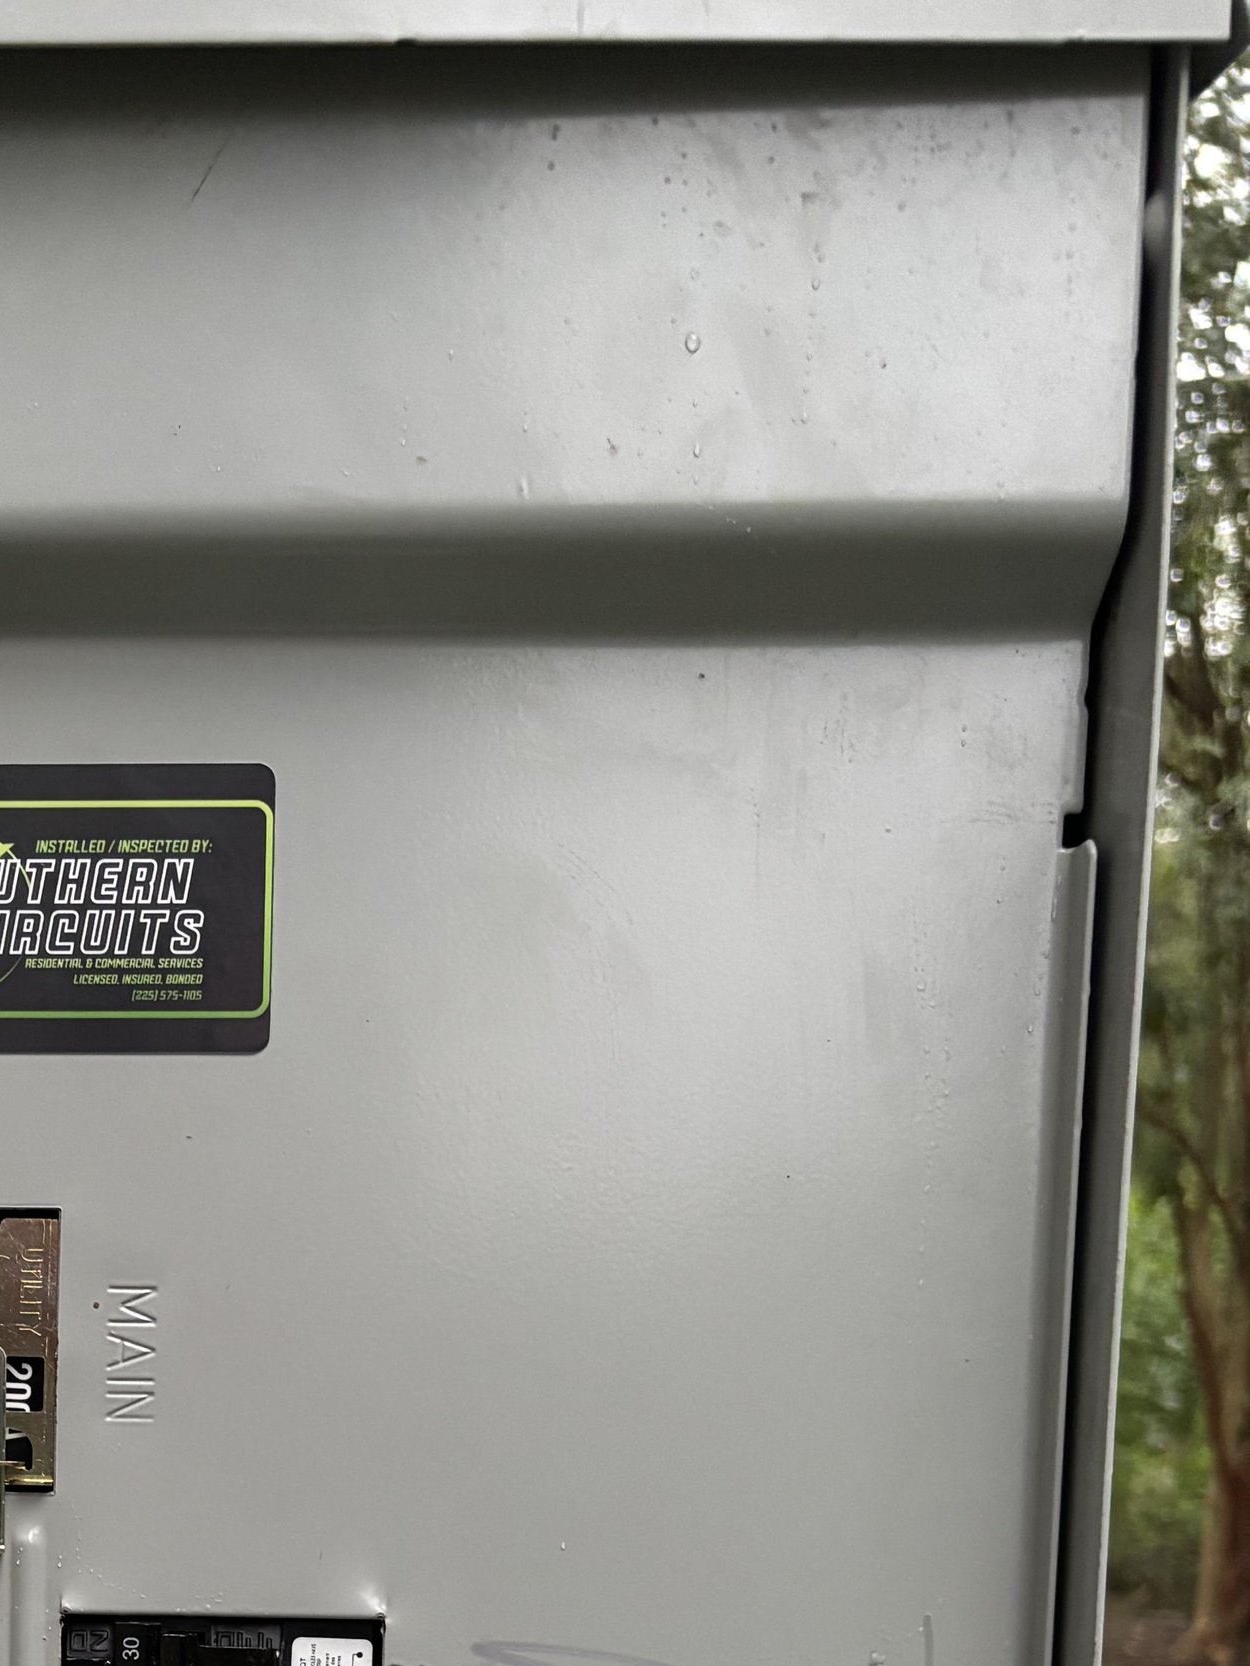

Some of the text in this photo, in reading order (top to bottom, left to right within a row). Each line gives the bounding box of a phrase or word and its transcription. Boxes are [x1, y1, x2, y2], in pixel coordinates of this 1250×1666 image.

[35, 839, 212, 852] INSTALLED INSPECTED BY:
[25, 958, 203, 968] RESIDENTIAL COMMERCIAL SERVICES
[165, 973, 203, 984] BONDED
[131, 989, 158, 1001] (225)
[19, 1248, 44, 1337] UTILITY
[104, 1283, 157, 1425] MAIN
[122, 1637, 140, 1661] 30
